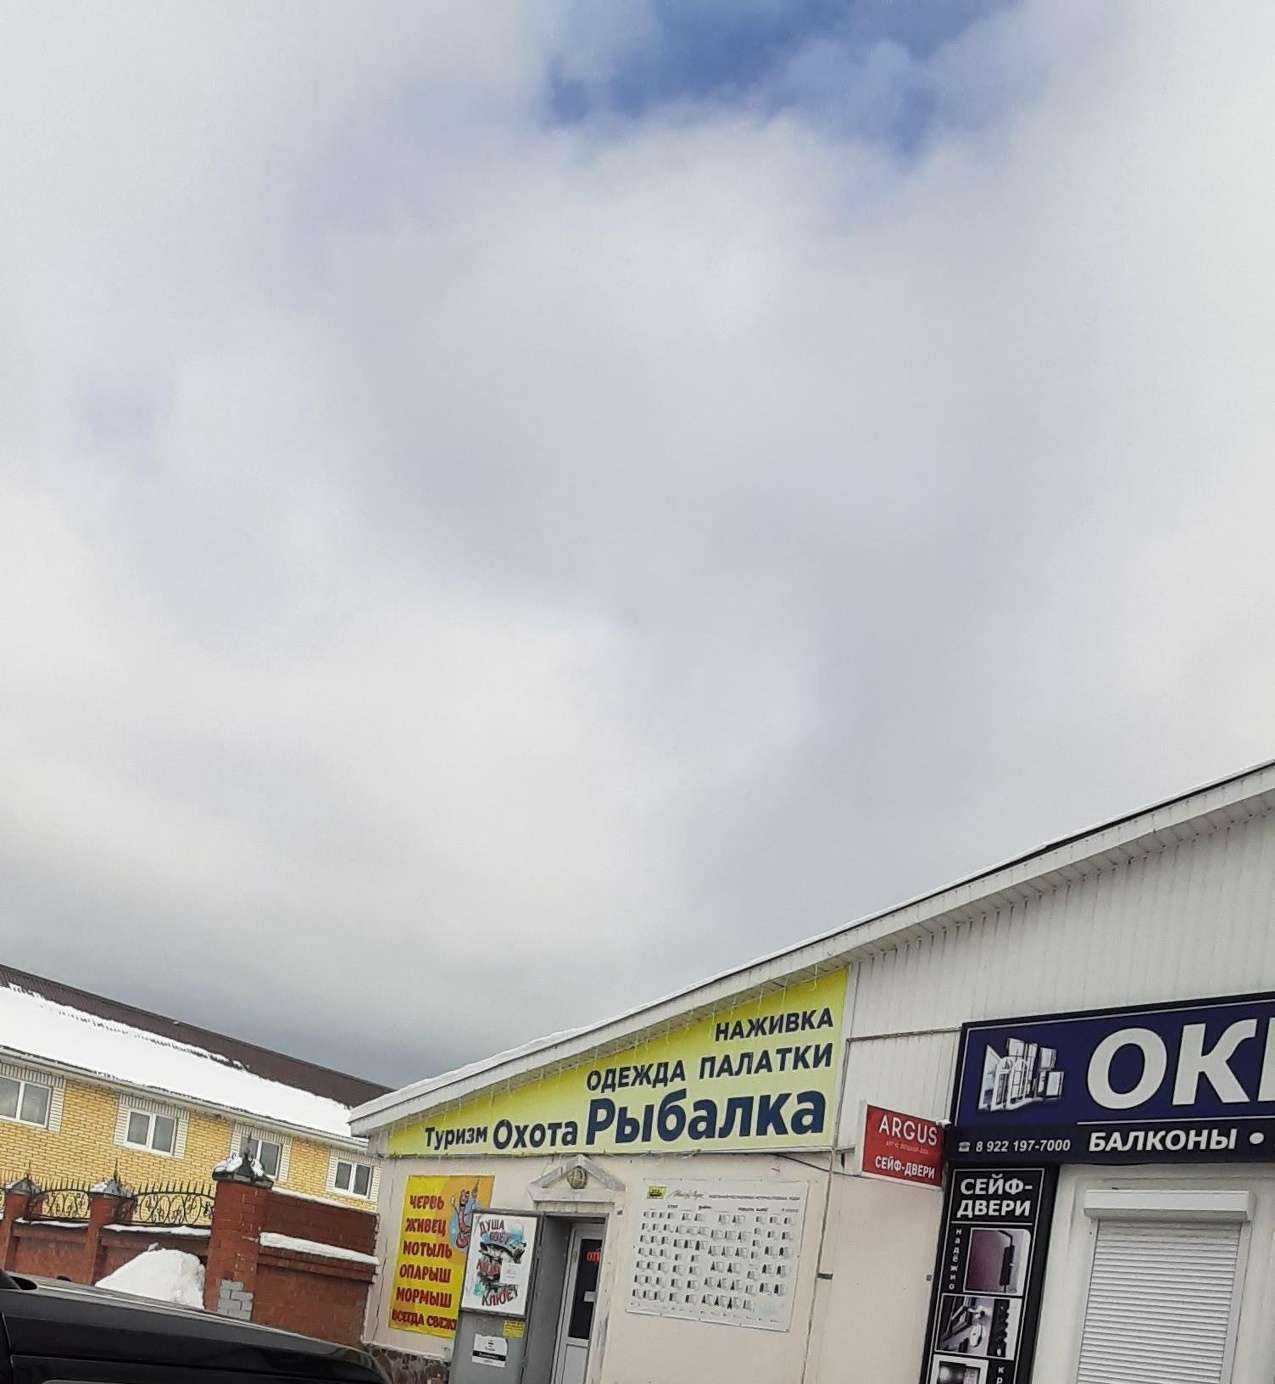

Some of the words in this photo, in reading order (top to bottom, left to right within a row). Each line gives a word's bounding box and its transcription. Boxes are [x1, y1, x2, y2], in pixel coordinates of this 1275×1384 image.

[715, 1008, 833, 1042] НАЖИВКА
[586, 1060, 686, 1093] ОДЕЖДА
[699, 1043, 832, 1080] ПАЛАТКИ
[1087, 1017, 1275, 1110] ОК
[425, 1126, 488, 1150] Туризм
[493, 1119, 578, 1149] Охота
[585, 1088, 826, 1145] Рыбалка
[878, 1114, 938, 1146] ARGUS
[975, 1140, 983, 1152] 8
[986, 1139, 1008, 1152] 922
[1013, 1138, 1071, 1152] 197-7000
[1088, 1128, 1238, 1152] БАЛКОНЫ
[874, 1154, 936, 1180] СЕЙФ-ДВЕРИ
[959, 1173, 1033, 1195] СЕЙФ-
[409, 1195, 445, 1210] ЧЕРВЬ
[956, 1199, 1031, 1218] ДВЕРИ
[405, 1217, 447, 1237] ЖИВЕЦ
[402, 1239, 453, 1260] МОТЫЛЬ
[399, 1263, 452, 1284] ОПАРЫШ
[396, 1286, 452, 1309] МОРМЫШ
